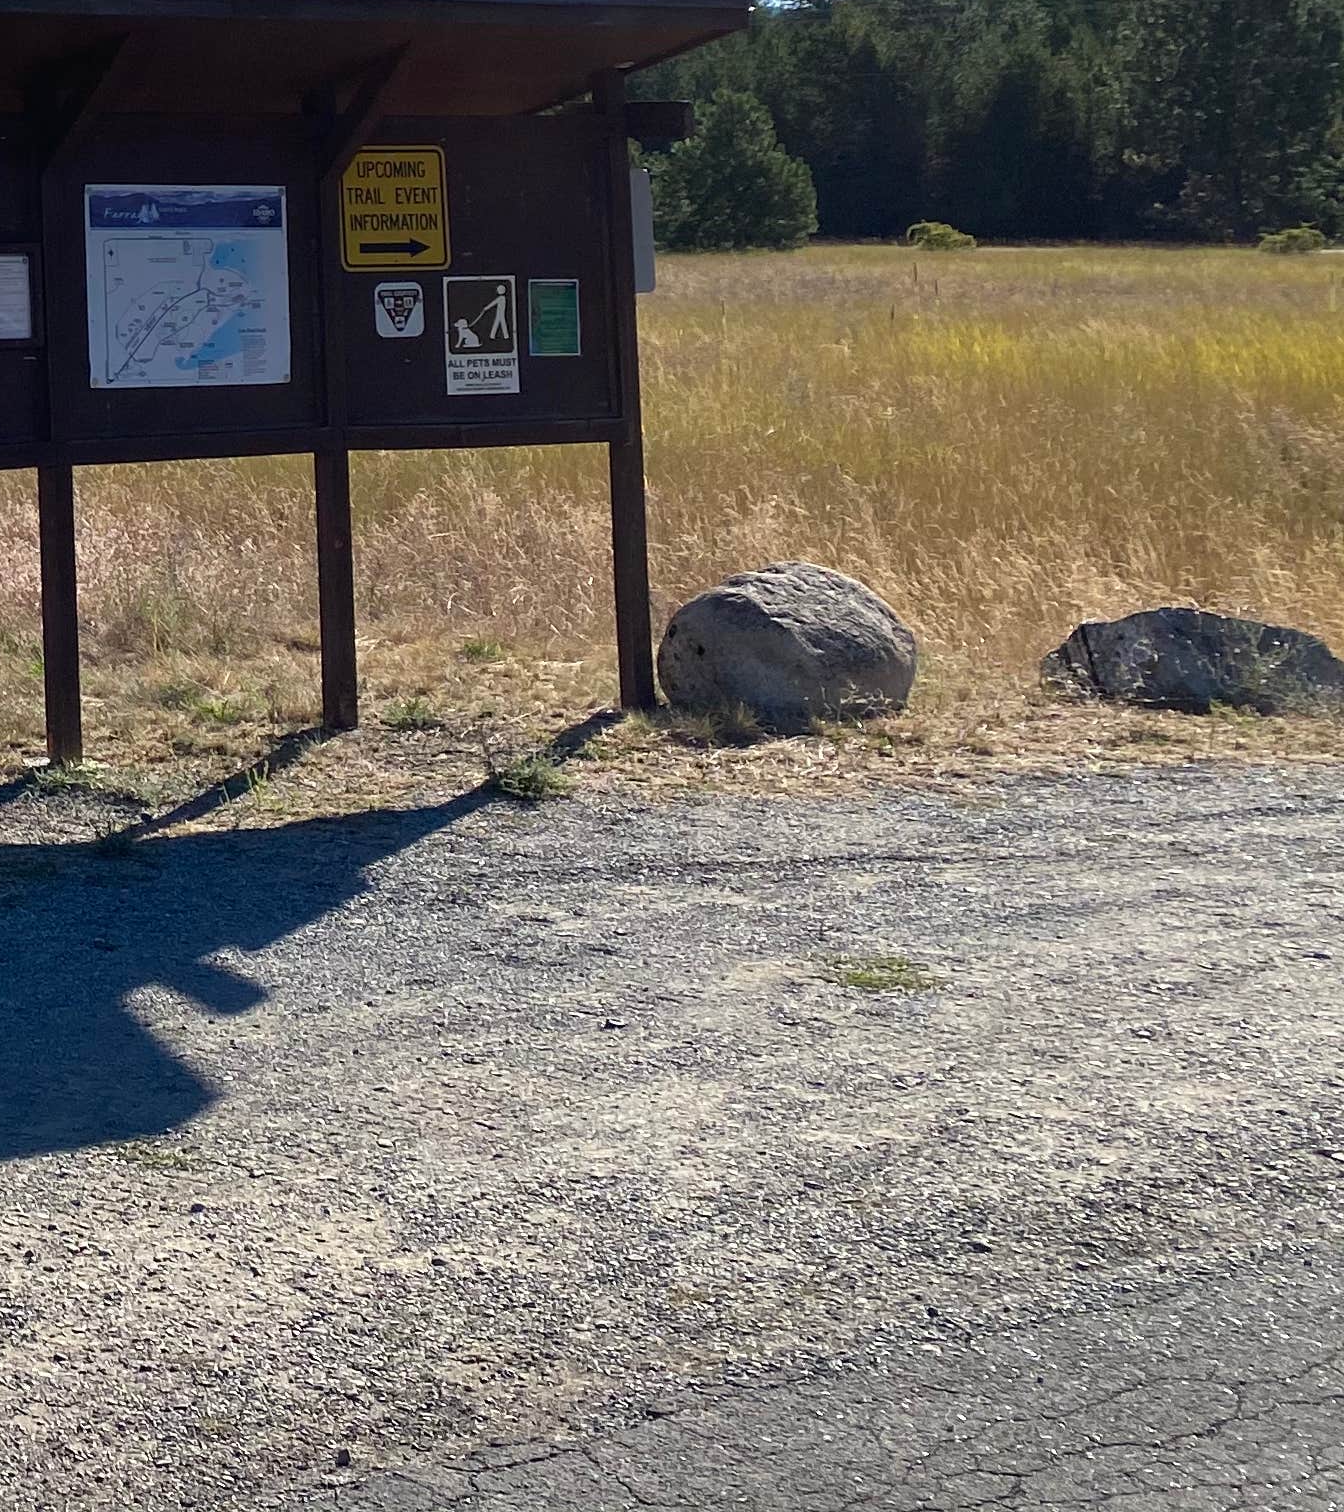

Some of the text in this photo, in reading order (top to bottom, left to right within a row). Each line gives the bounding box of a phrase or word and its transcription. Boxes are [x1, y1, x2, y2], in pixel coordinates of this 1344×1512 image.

[356, 160, 426, 179] UPCOMING
[346, 187, 438, 205] TRAIL EVENT
[349, 213, 438, 231] INFORMATION
[448, 357, 516, 368] ALL PETS MUST
[452, 370, 513, 381] BE ON LEASH
